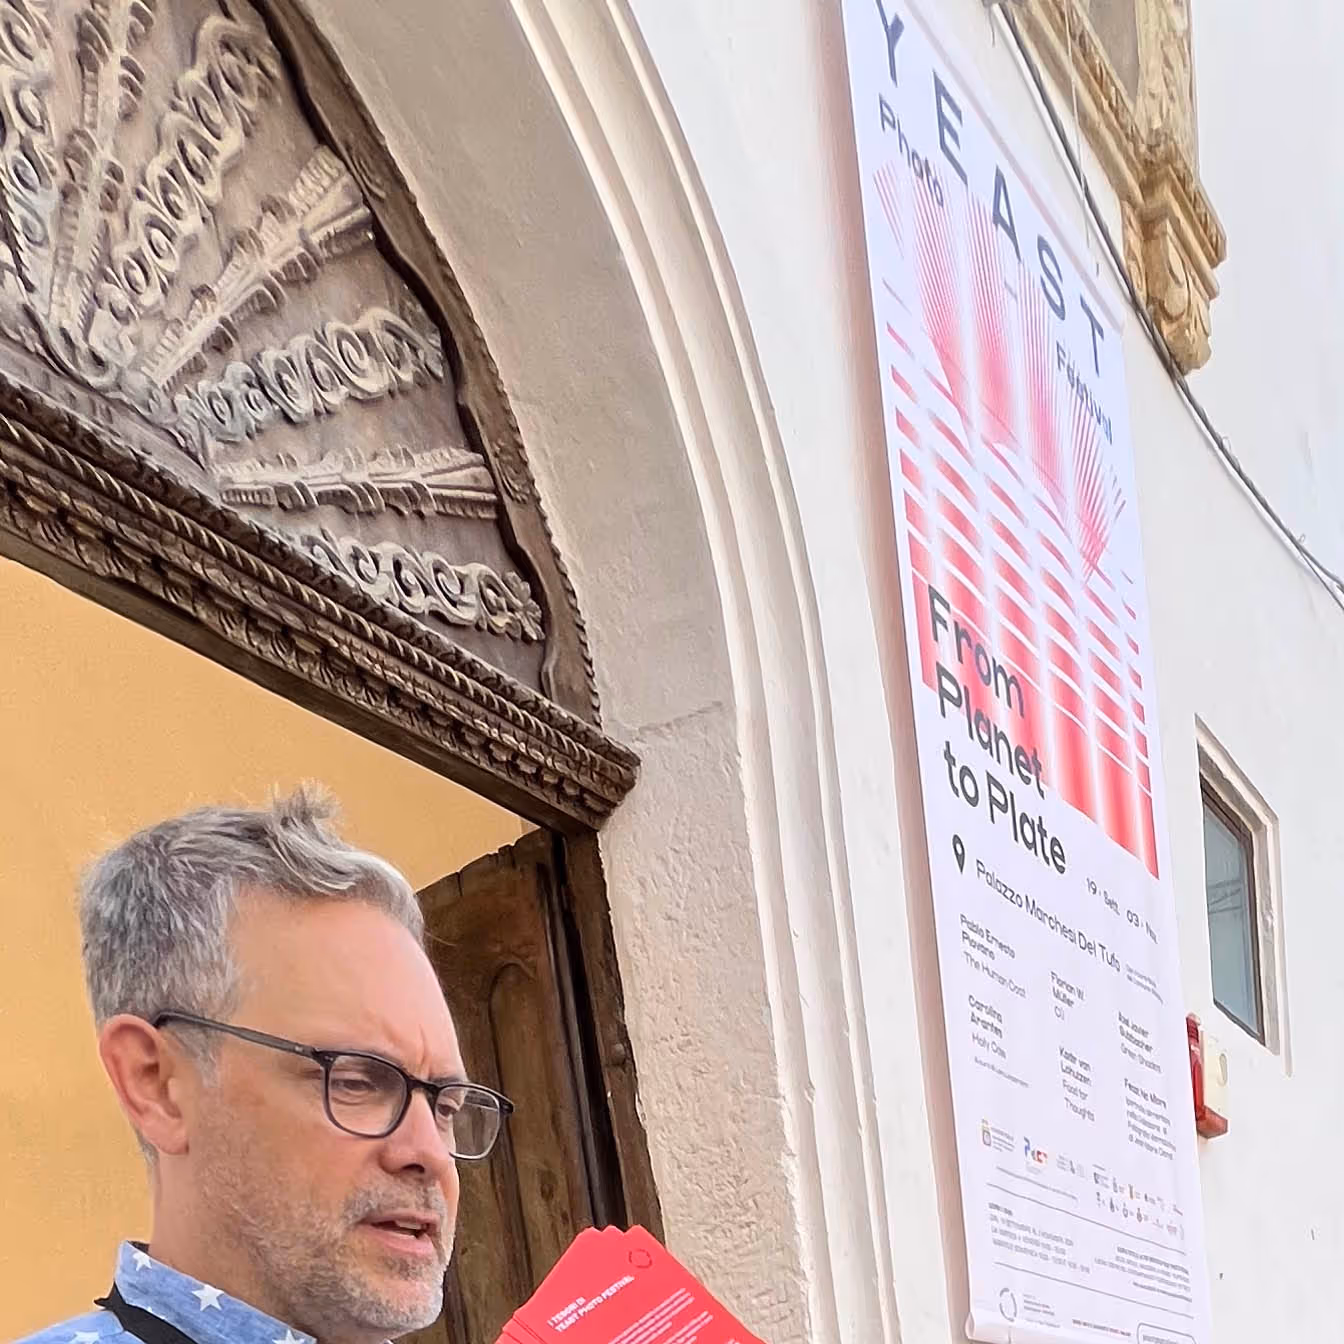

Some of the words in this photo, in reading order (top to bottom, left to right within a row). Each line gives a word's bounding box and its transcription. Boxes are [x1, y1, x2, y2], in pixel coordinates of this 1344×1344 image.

[878, 92, 944, 210] Photo
[927, 583, 1025, 719] From
[936, 660, 1046, 800] Planet
[943, 740, 980, 808] to
[985, 769, 1067, 875] Plate
[976, 859, 1023, 909] Palazzo
[1024, 894, 1077, 945] Marchesi
[1077, 931, 1097, 958] Del
[1099, 943, 1121, 973] Tufo
